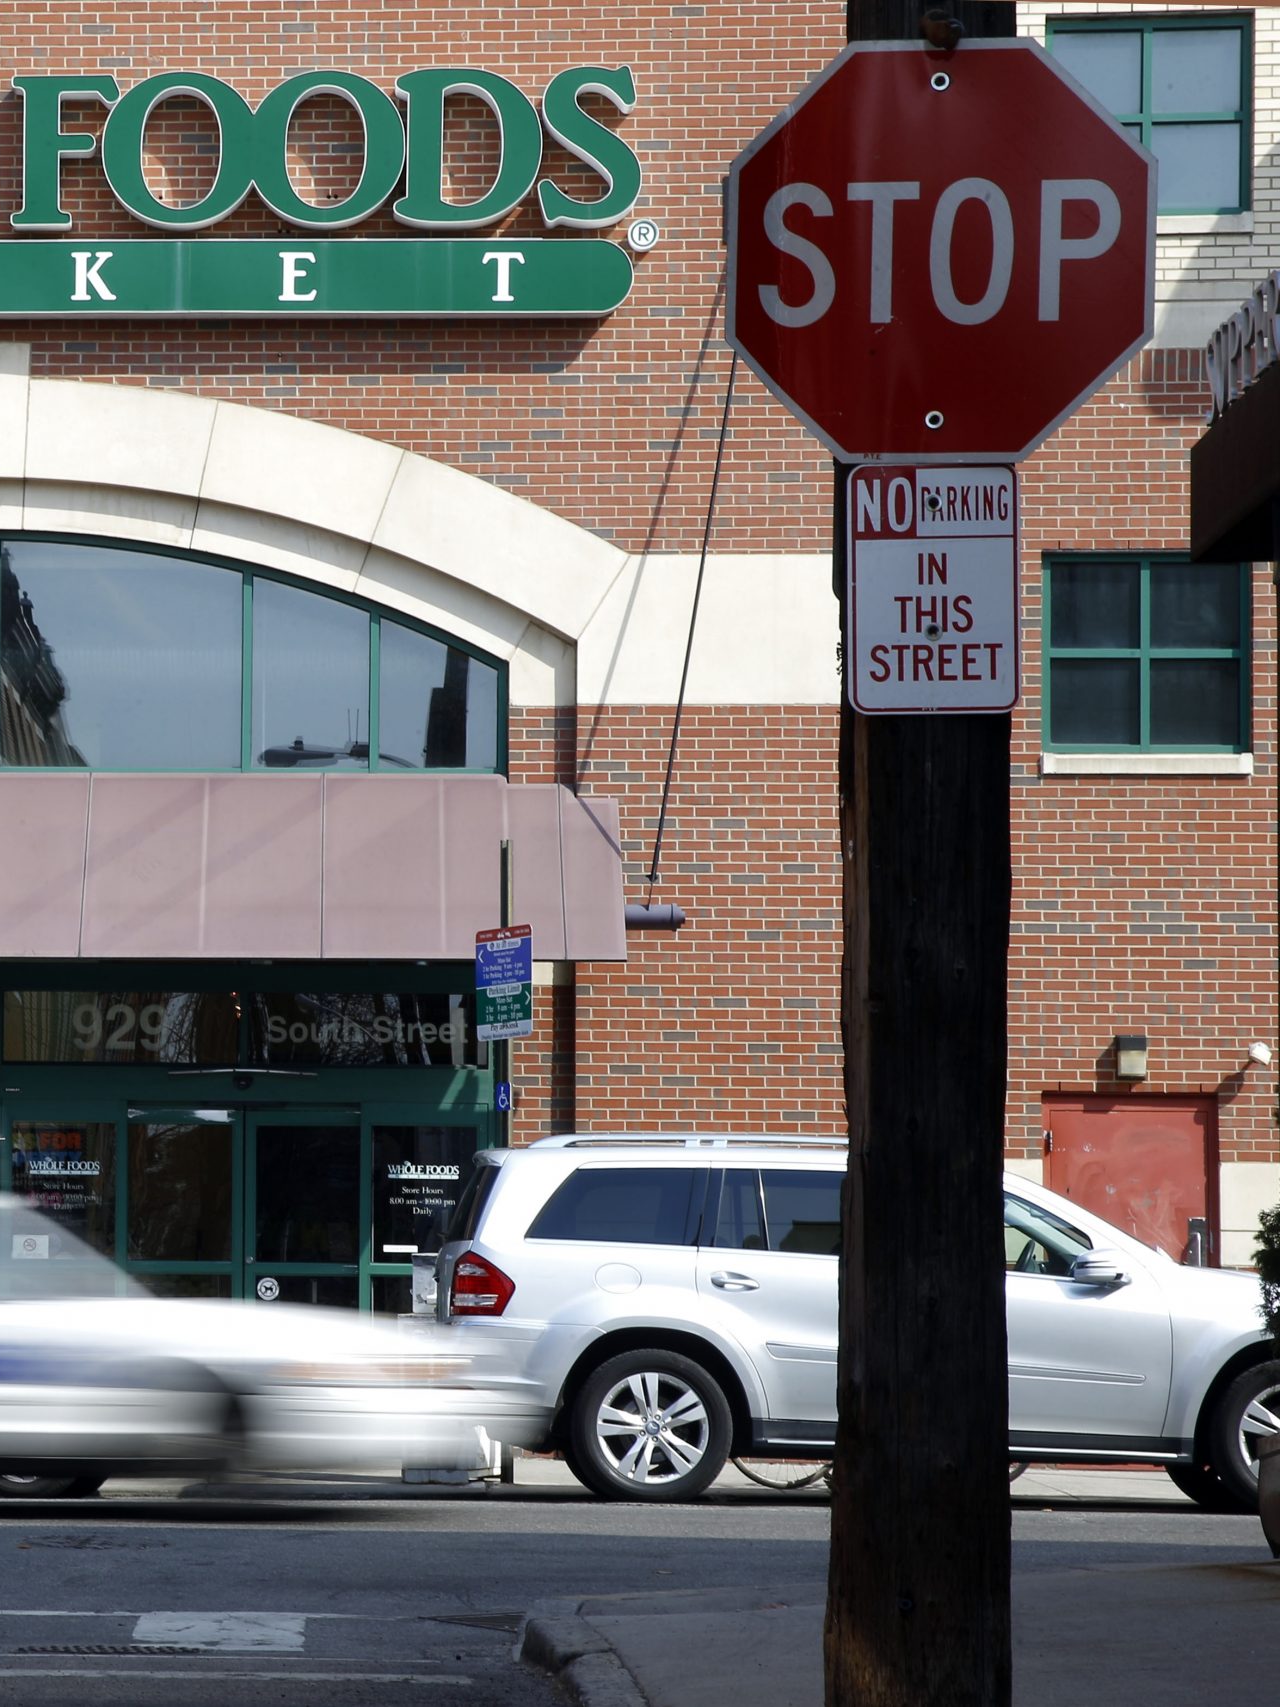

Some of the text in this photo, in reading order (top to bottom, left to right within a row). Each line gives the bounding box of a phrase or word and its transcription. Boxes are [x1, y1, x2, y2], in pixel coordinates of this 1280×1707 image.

[10, 65, 643, 232] FOODS
[757, 176, 1122, 328] STOP
[856, 476, 1009, 533] NO PARKING
[917, 552, 948, 586] IN
[893, 594, 974, 634] THIS
[869, 642, 1003, 683] STREET
[72, 1003, 168, 1052] 929
[268, 1015, 469, 1044] South Street
[29, 1160, 100, 1171] WHOLE FOODS
[387, 1163, 460, 1175] WHOLE FOODS
[401, 1186, 444, 1194] Store Hours
[443, 1199, 456, 1208] pm
[412, 1207, 433, 1217] Daily
